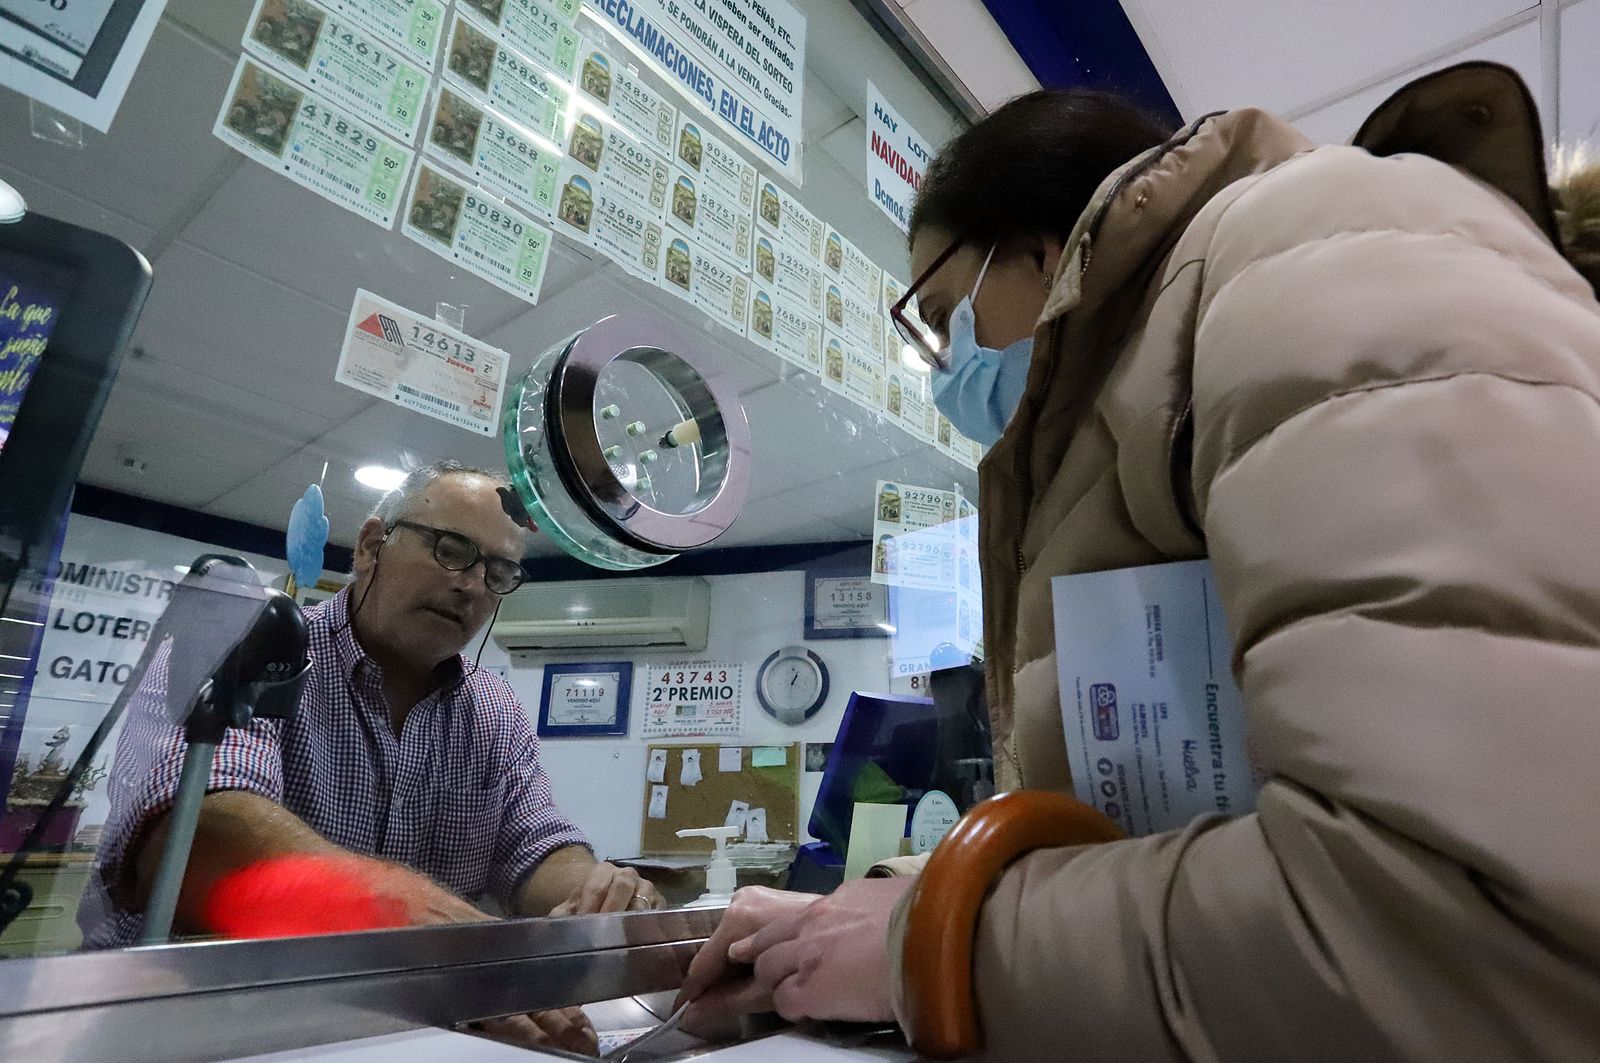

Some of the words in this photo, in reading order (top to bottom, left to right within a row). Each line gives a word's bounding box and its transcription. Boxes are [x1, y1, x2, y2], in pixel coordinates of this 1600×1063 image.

[752, 1, 777, 34] PEÑAS,
[329, 23, 398, 71] 14617
[667, 1, 680, 19] SE
[679, 11, 719, 55] PONDRÁN
[718, 48, 724, 61] A
[725, 53, 735, 71] LA
[737, 62, 762, 94] VENTA.
[708, 6, 744, 50] VISPERA
[745, 41, 761, 66] DEL
[762, 58, 793, 94] SORTEO
[748, 21, 761, 37] ser
[762, 34, 794, 71] retirados
[497, 51, 548, 92] 96866
[616, 73, 657, 107] 34897
[303, 104, 378, 152] 41829
[485, 120, 538, 161] 13688
[720, 89, 739, 119] EN
[739, 107, 756, 137] EL
[758, 121, 790, 162] ACTO
[874, 102, 898, 133] HAY
[907, 136, 932, 164] LOT
[609, 134, 652, 168] 57605
[706, 142, 741, 173] 90321
[374, 189, 387, 200] 20
[700, 193, 736, 223] 58751
[465, 195, 523, 236] 90830
[600, 197, 643, 231] 13689
[695, 255, 733, 285] 39672
[780, 252, 810, 277] 12222
[776, 305, 807, 330] 76849
[411, 325, 475, 363] 14613
[446, 357, 476, 374] Jueves
[904, 490, 941, 504] 92796
[830, 591, 872, 602] 13158
[53, 608, 153, 642] LOTER
[565, 687, 605, 697] 71119
[661, 670, 728, 685] 43743
[668, 685, 734, 702] PREMIO
[1205, 683, 1224, 769] Encuentra
[1182, 739, 1200, 793] Huelva
[1213, 773, 1226, 792] tu
